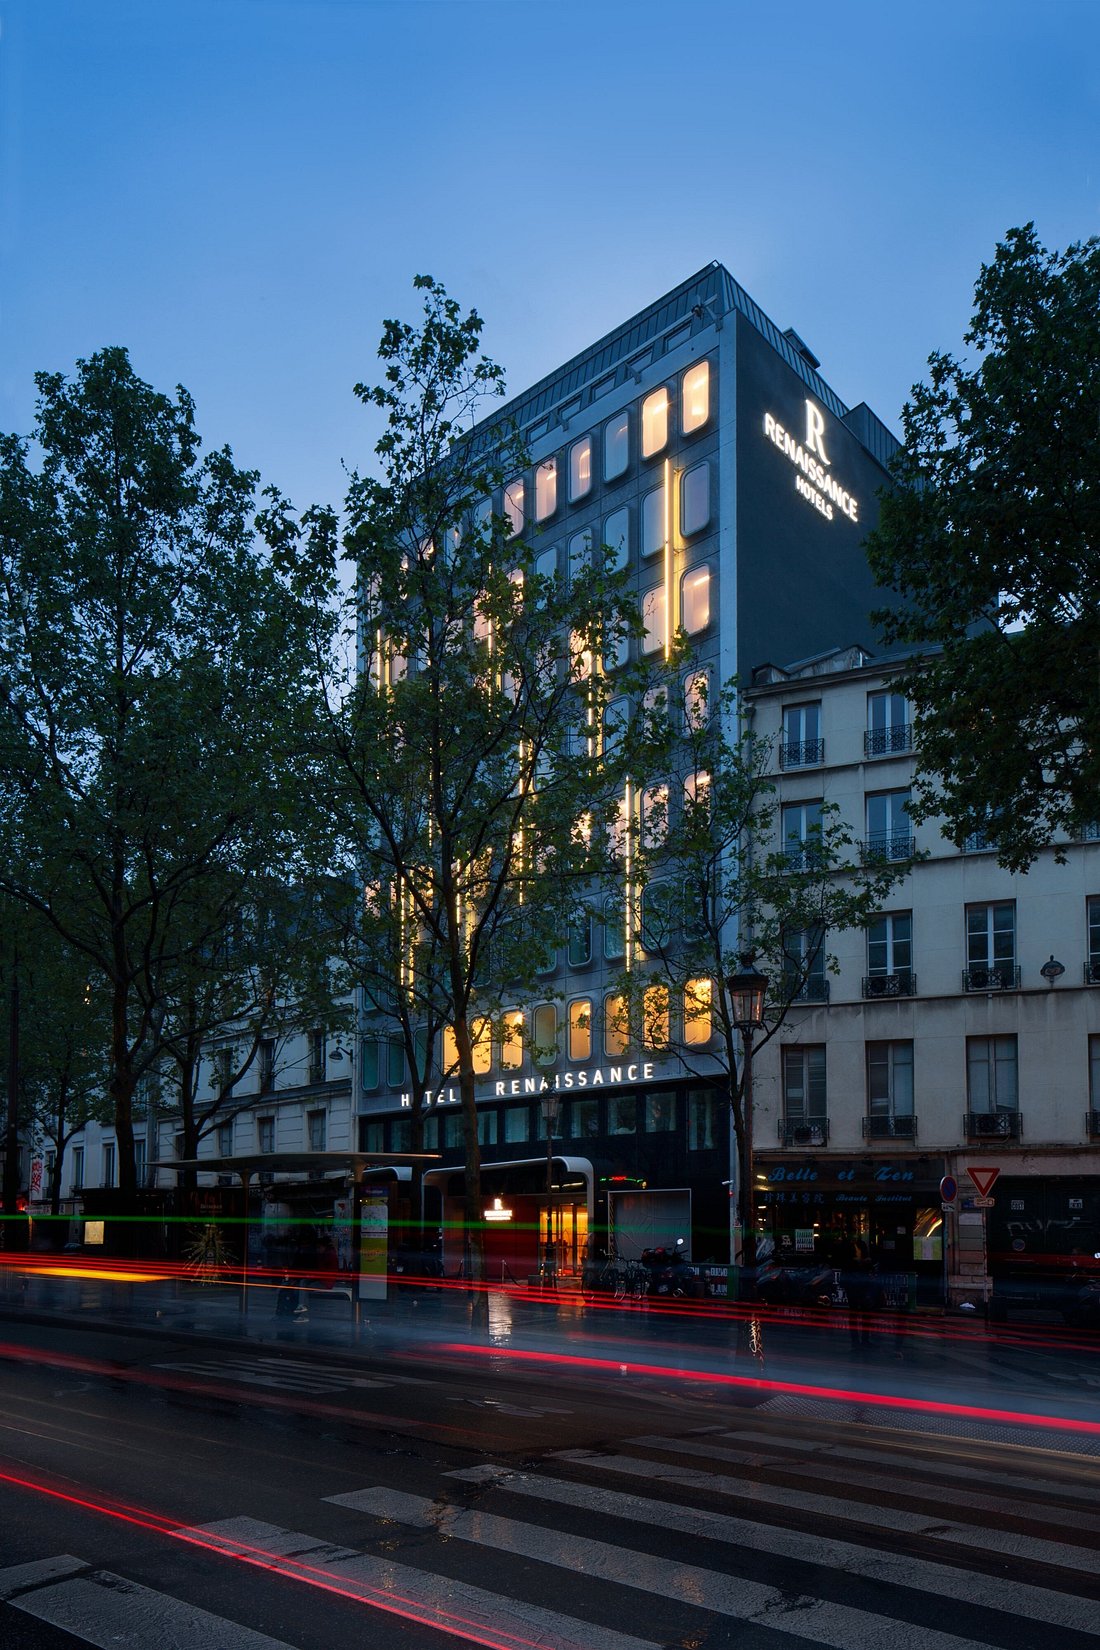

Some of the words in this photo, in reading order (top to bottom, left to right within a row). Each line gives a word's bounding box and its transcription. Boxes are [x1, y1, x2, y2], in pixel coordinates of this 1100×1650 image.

[805, 399, 831, 465] R
[764, 412, 858, 522] RENAISSANCE
[796, 474, 833, 520] HOTELS
[401, 1088, 456, 1107] HTEL
[495, 1063, 654, 1096] RENAISSANCE
[873, 1166, 914, 1182] Zen
